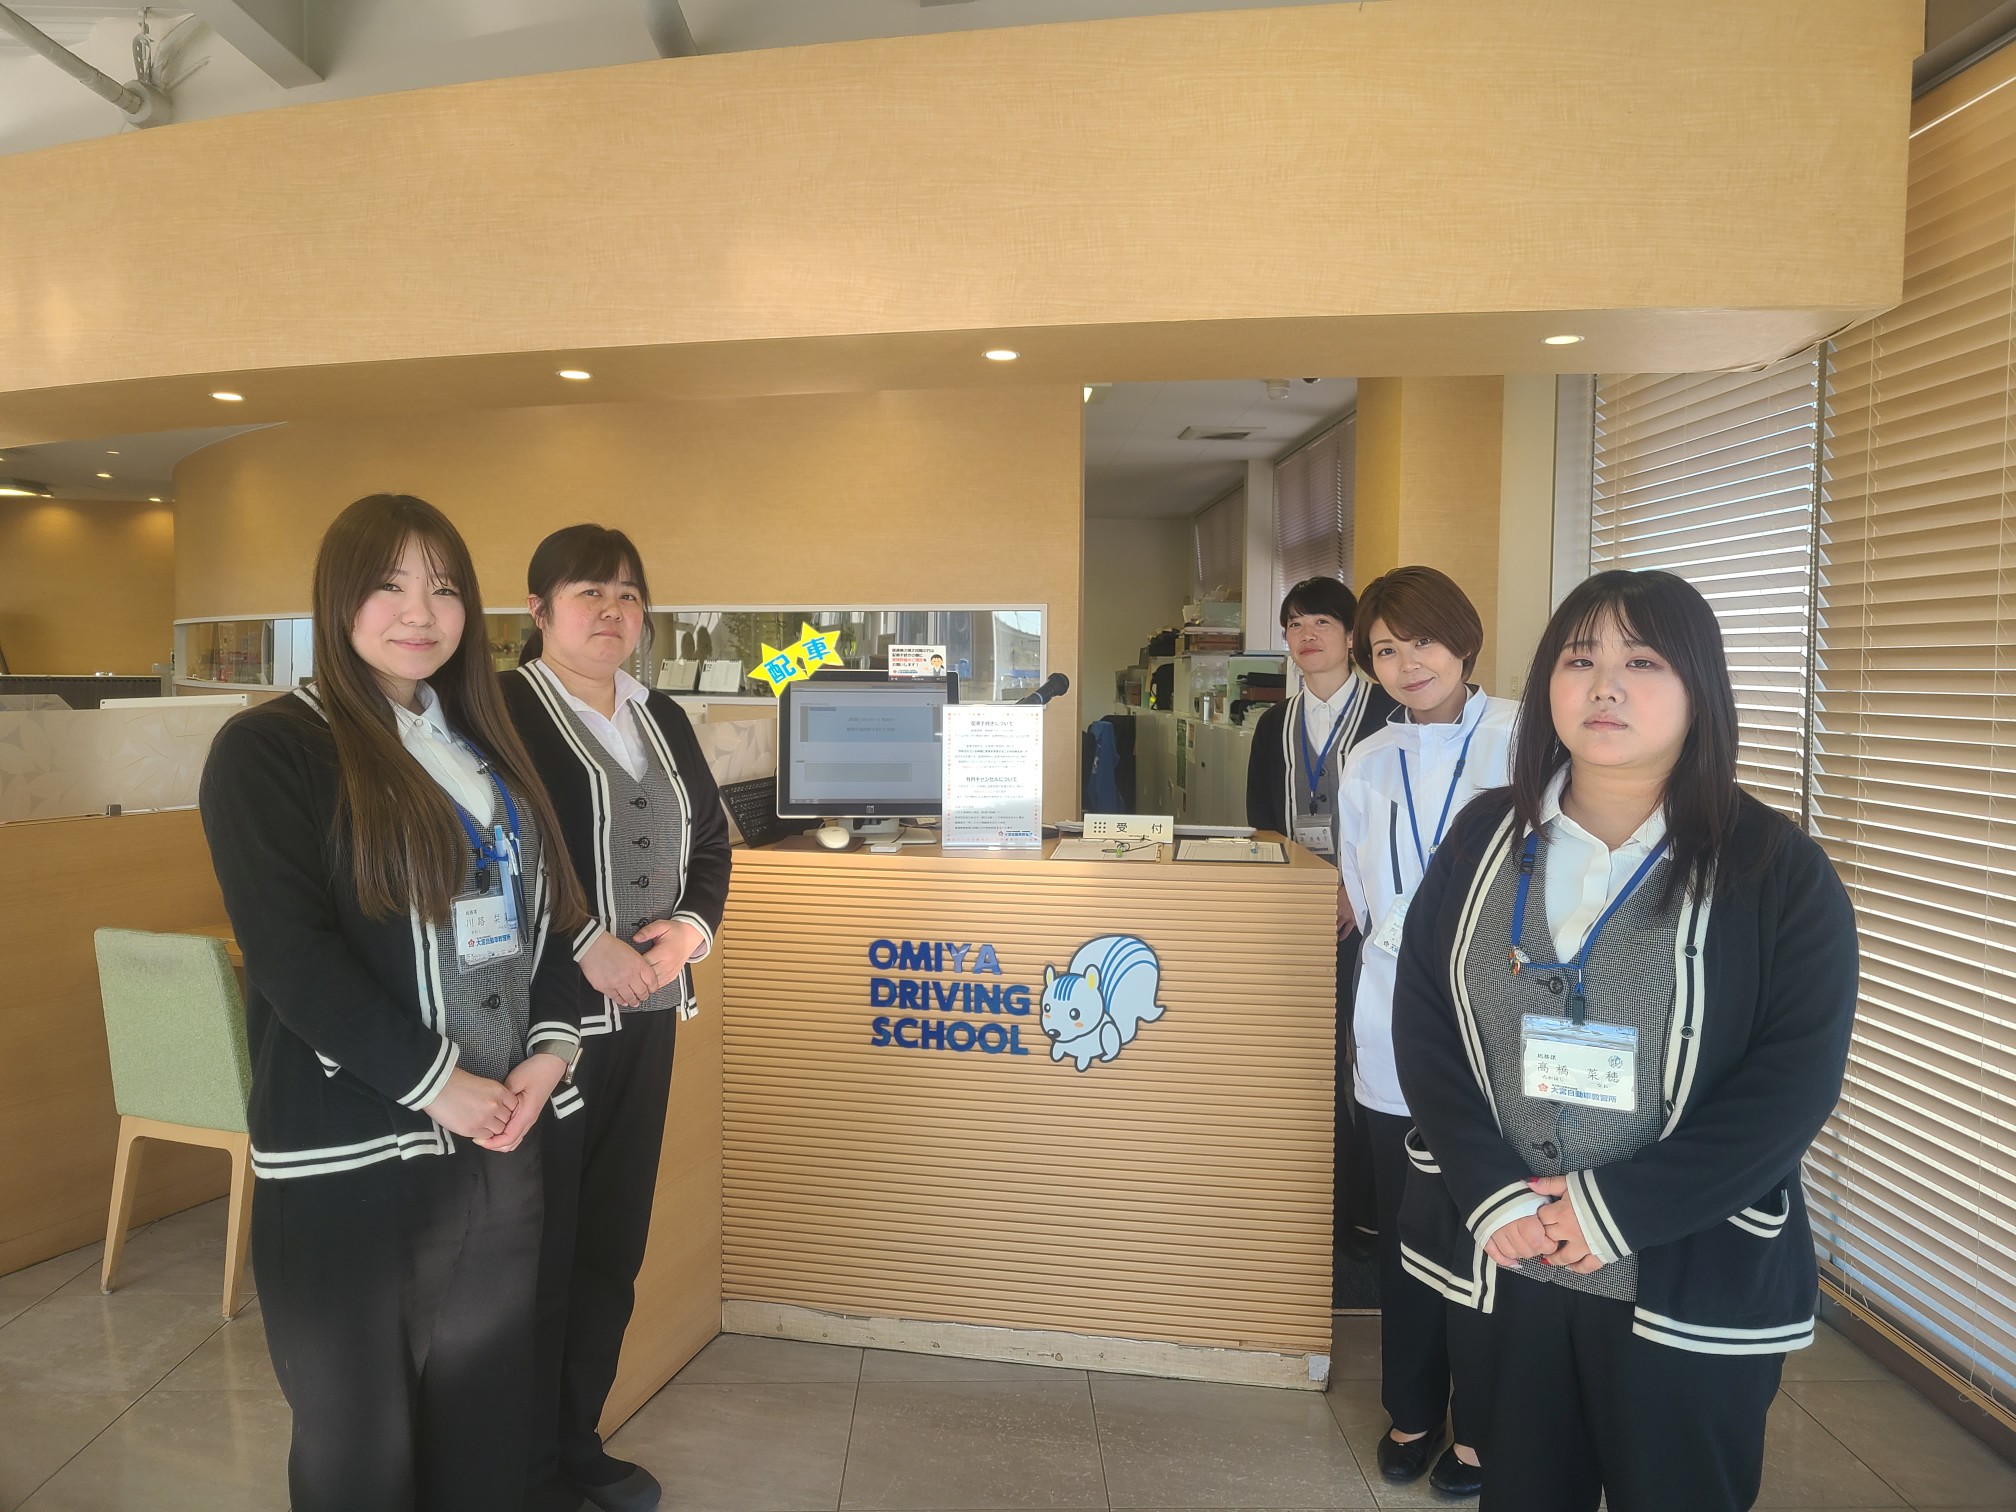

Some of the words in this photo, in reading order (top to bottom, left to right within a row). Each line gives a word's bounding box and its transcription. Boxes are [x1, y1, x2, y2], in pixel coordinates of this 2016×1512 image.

[763, 637, 831, 684] 配車
[1116, 822, 1163, 834] 受付
[868, 939, 1002, 976] OMIYA
[870, 977, 1031, 1016] DRIVING
[871, 1016, 1029, 1056] SCHOOL
[1551, 1086, 1617, 1103] 大宮自動車教習所
